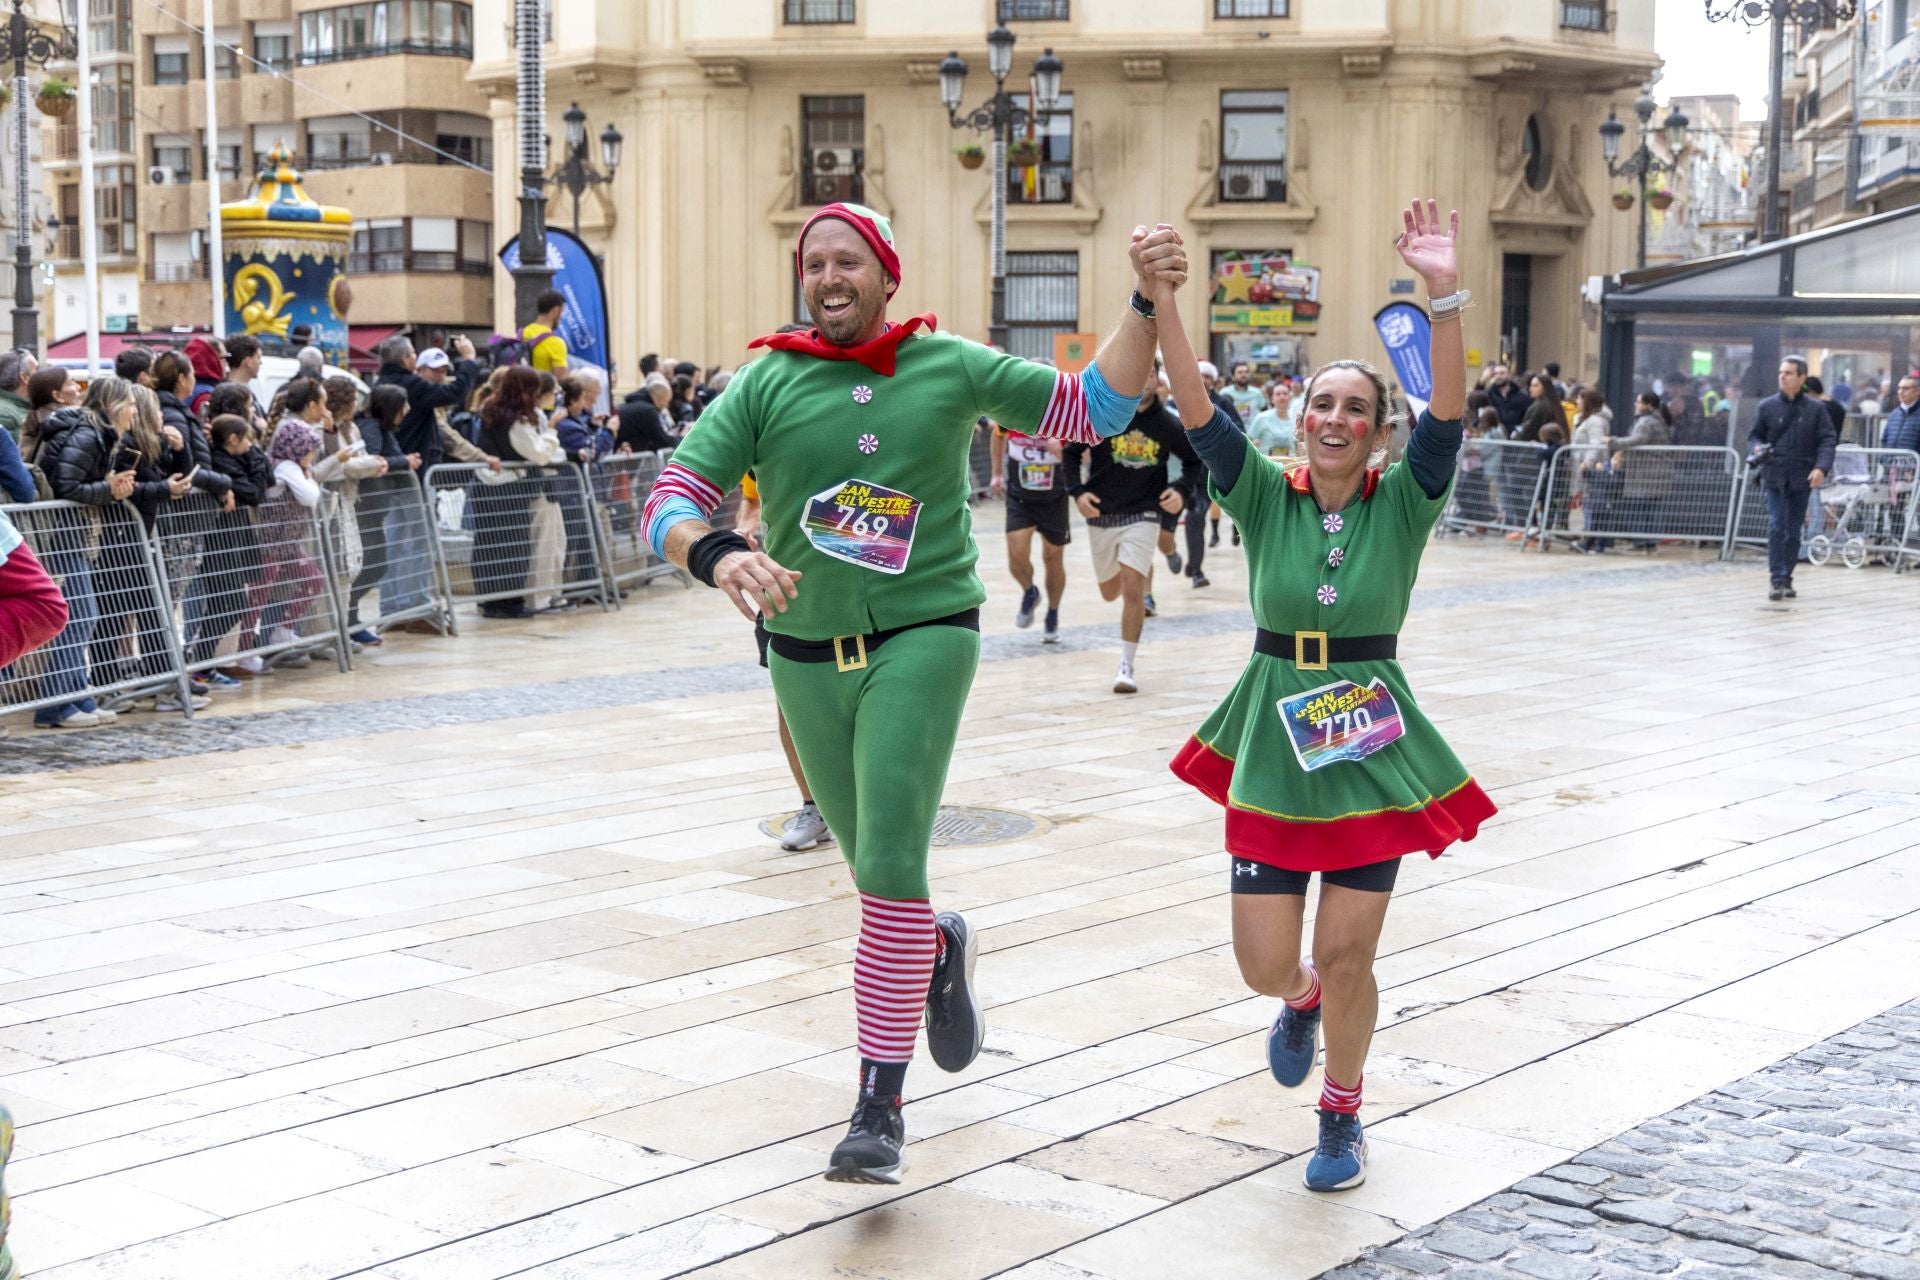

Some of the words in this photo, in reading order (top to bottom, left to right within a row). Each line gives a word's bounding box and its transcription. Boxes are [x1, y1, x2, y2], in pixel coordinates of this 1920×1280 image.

[1251, 312, 1288, 322] ONCE
[835, 494, 913, 509] SILVESTRE
[835, 505, 889, 540] 769
[1306, 692, 1335, 713] SAN
[1316, 707, 1373, 745] 770
